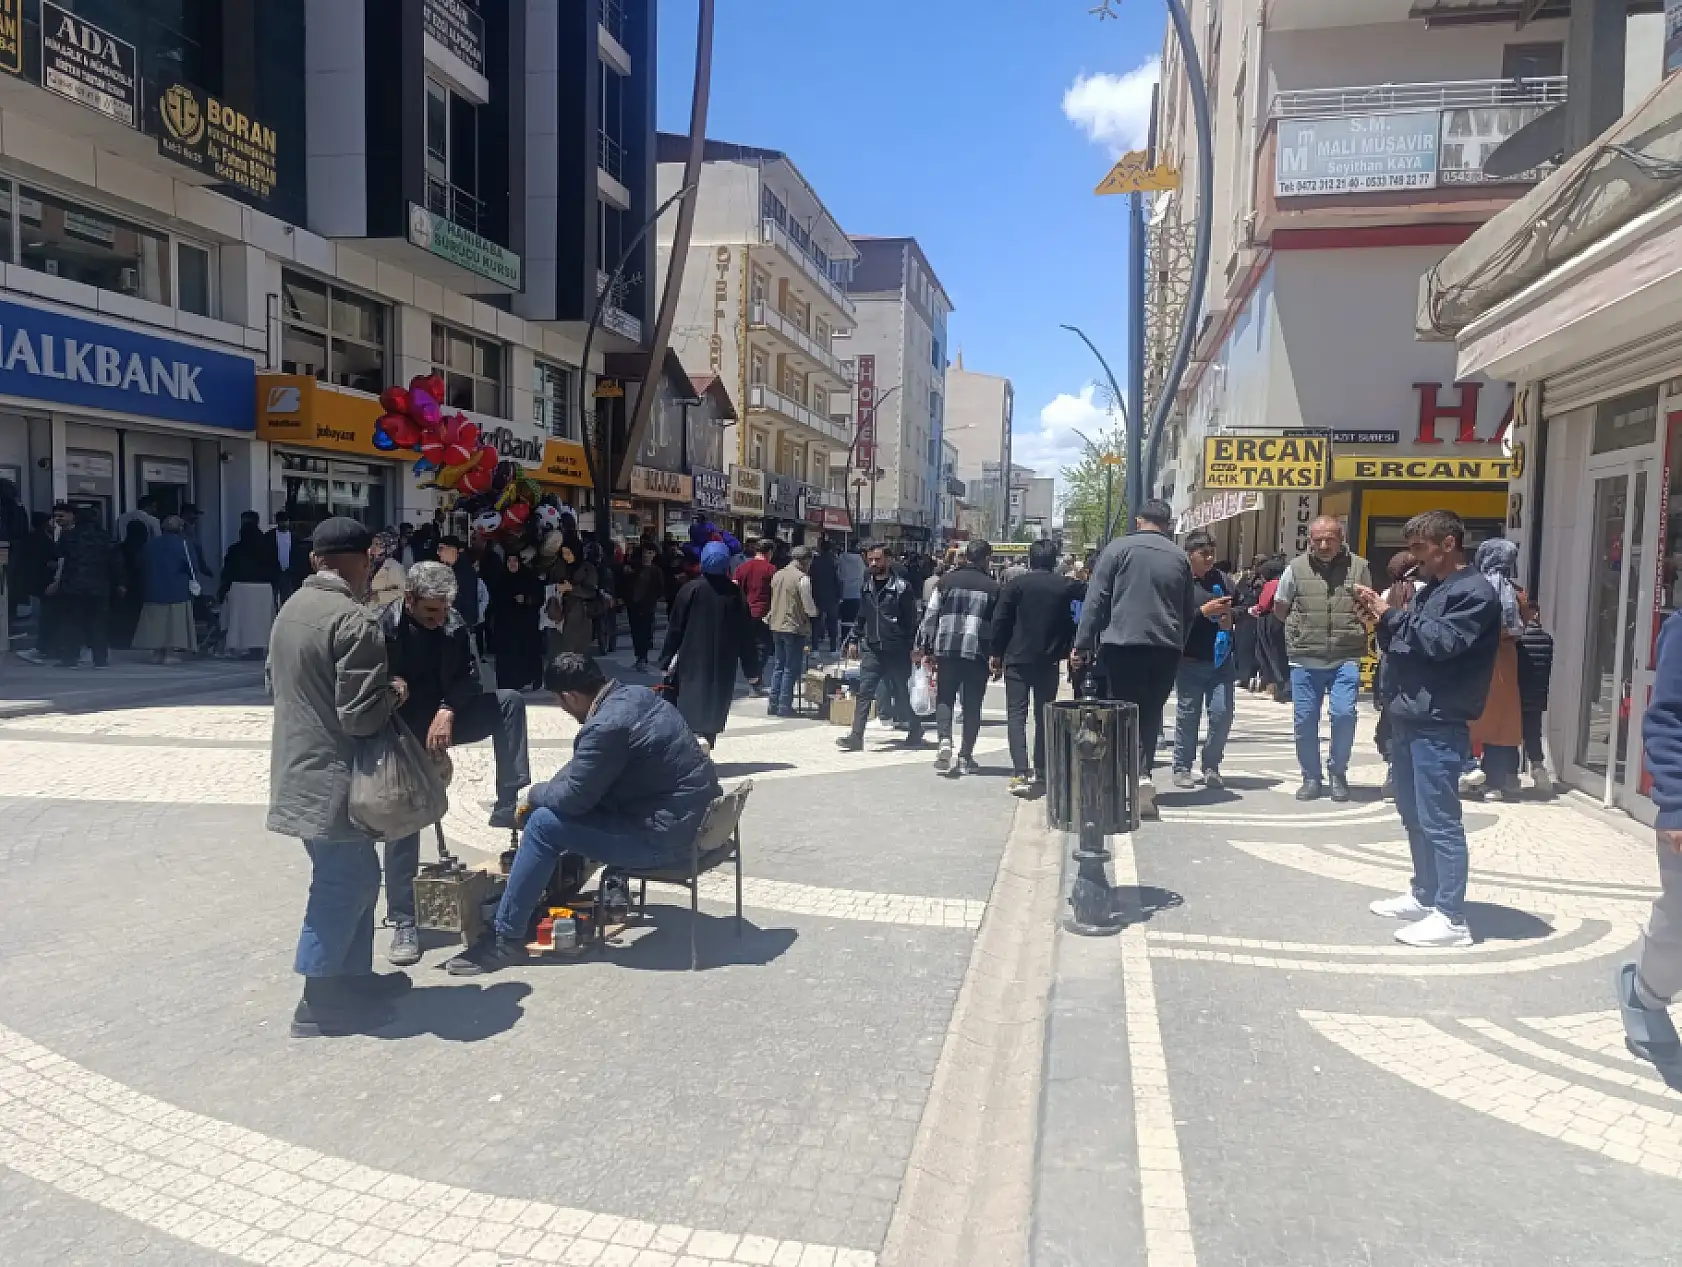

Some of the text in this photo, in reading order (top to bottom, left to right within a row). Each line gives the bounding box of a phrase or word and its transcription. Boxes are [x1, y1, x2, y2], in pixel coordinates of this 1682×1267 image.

[56, 16, 121, 68] ADA
[207, 97, 276, 154] BORAN
[1388, 156, 1422, 170] KAYA
[860, 367, 873, 461] HOTEL
[1215, 439, 1323, 462] ERCAN
[1208, 474, 1238, 485] AÇIK
[1240, 463, 1322, 486] TAKSİ
[1355, 462, 1481, 478] ERCAN
